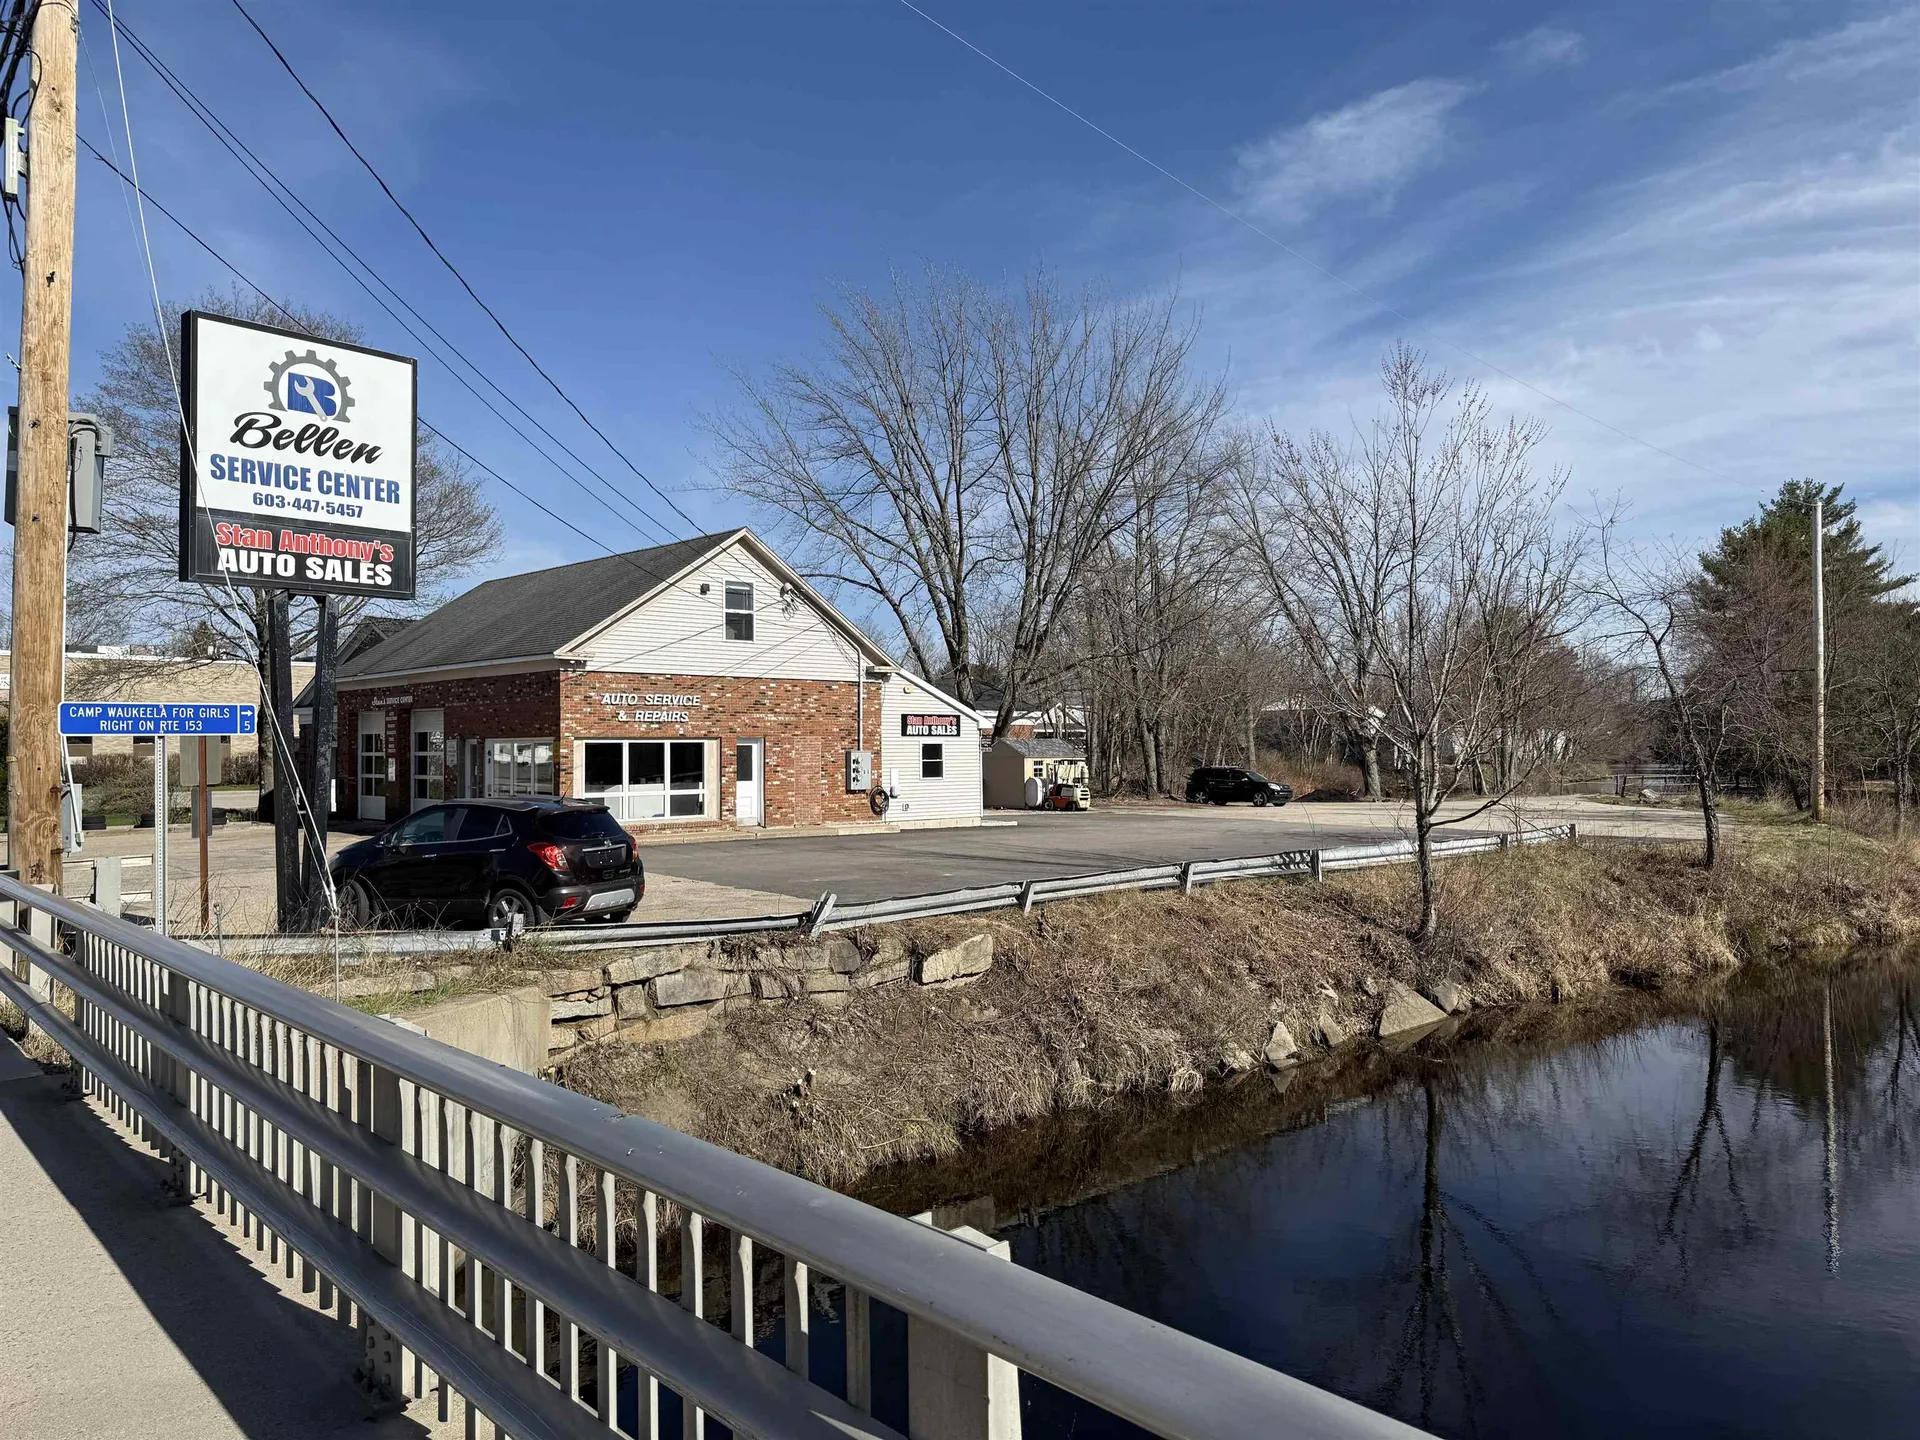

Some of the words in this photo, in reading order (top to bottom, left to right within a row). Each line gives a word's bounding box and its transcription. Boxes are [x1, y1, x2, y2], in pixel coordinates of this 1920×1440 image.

[230, 412, 383, 464] Bellen
[210, 453, 312, 493] SERVICE
[317, 469, 400, 504] CENTER
[216, 522, 273, 550] Stan
[279, 529, 394, 563] Anthony's
[217, 548, 296, 577] AUTO
[305, 556, 392, 586] SALES
[601, 693, 638, 705] AUTO
[645, 694, 701, 706] SERVICE
[69, 707, 103, 717] CAMP
[107, 707, 166, 718] WAUKEELA
[172, 707, 194, 718] FOR
[199, 708, 230, 718] GIRLS
[618, 710, 628, 722] &
[635, 711, 689, 722] REPAIRS
[100, 721, 133, 731] RIGHT
[138, 721, 155, 731] ON
[160, 721, 180, 731] RTE
[185, 721, 203, 731] 153
[243, 721, 251, 731] 5
[907, 715, 923, 725] Stan
[906, 725, 929, 735] AUTO
[931, 725, 958, 736] SALES
